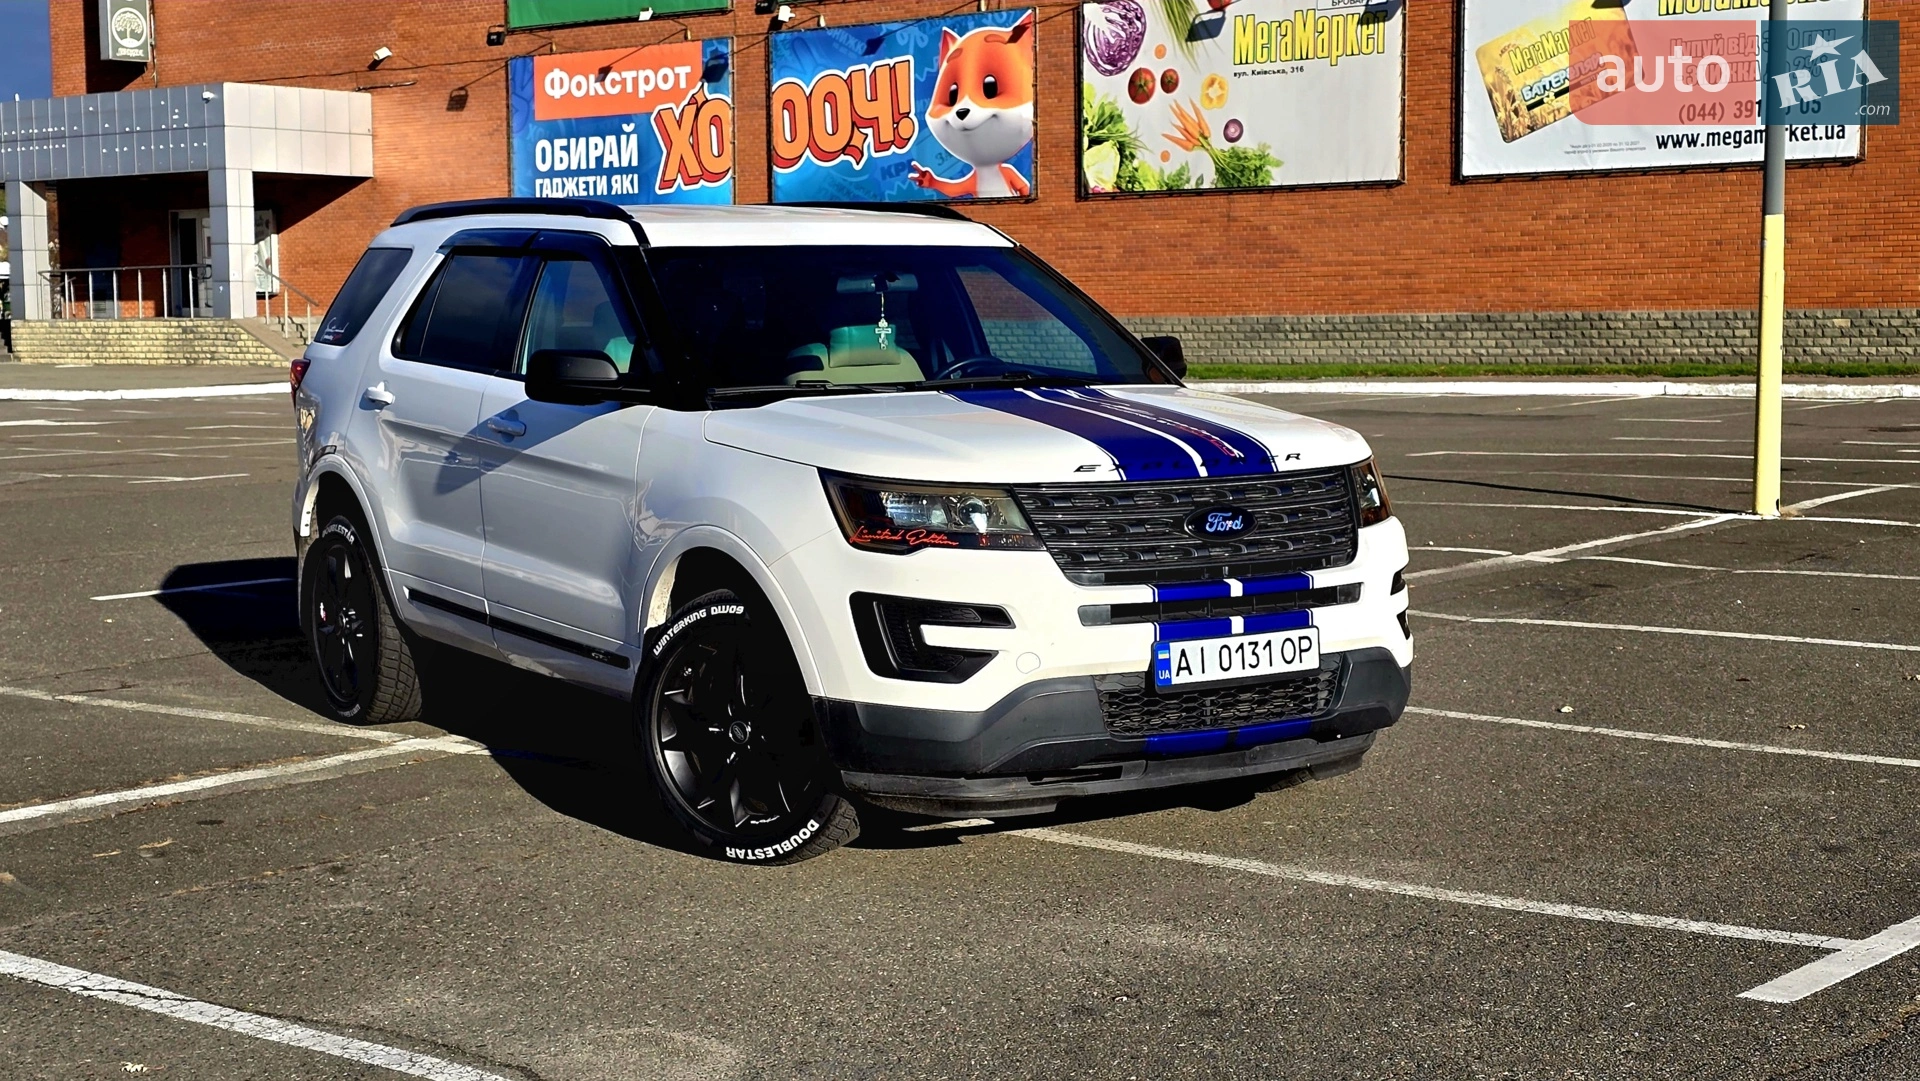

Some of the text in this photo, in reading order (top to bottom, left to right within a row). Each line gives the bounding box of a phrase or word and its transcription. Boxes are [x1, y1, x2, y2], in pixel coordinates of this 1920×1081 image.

[1233, 9, 1388, 66] МегаМаркет
[1508, 17, 1596, 76] МегаМаркет
[544, 65, 692, 100] Фокстрот
[1233, 66, 1305, 79] вул. Київська, 316
[771, 59, 916, 168] ООЧ!
[1678, 101, 1725, 125] (044)
[1733, 99, 1763, 119] 391
[535, 123, 639, 172] ОБИРАЙ
[653, 98, 732, 190] ХО
[1655, 122, 1846, 150] www.megamket.ua
[535, 173, 639, 198] ГАДЖЕТИ ЯКІ
[850, 525, 959, 546] Limited Edition
[1205, 511, 1244, 533] Ford
[652, 604, 745, 656] WINTERKING DW09
[1158, 669, 1171, 680] UA
[1175, 635, 1313, 678] AI 0131 OP
[725, 818, 820, 860] DOUBLESTAR
